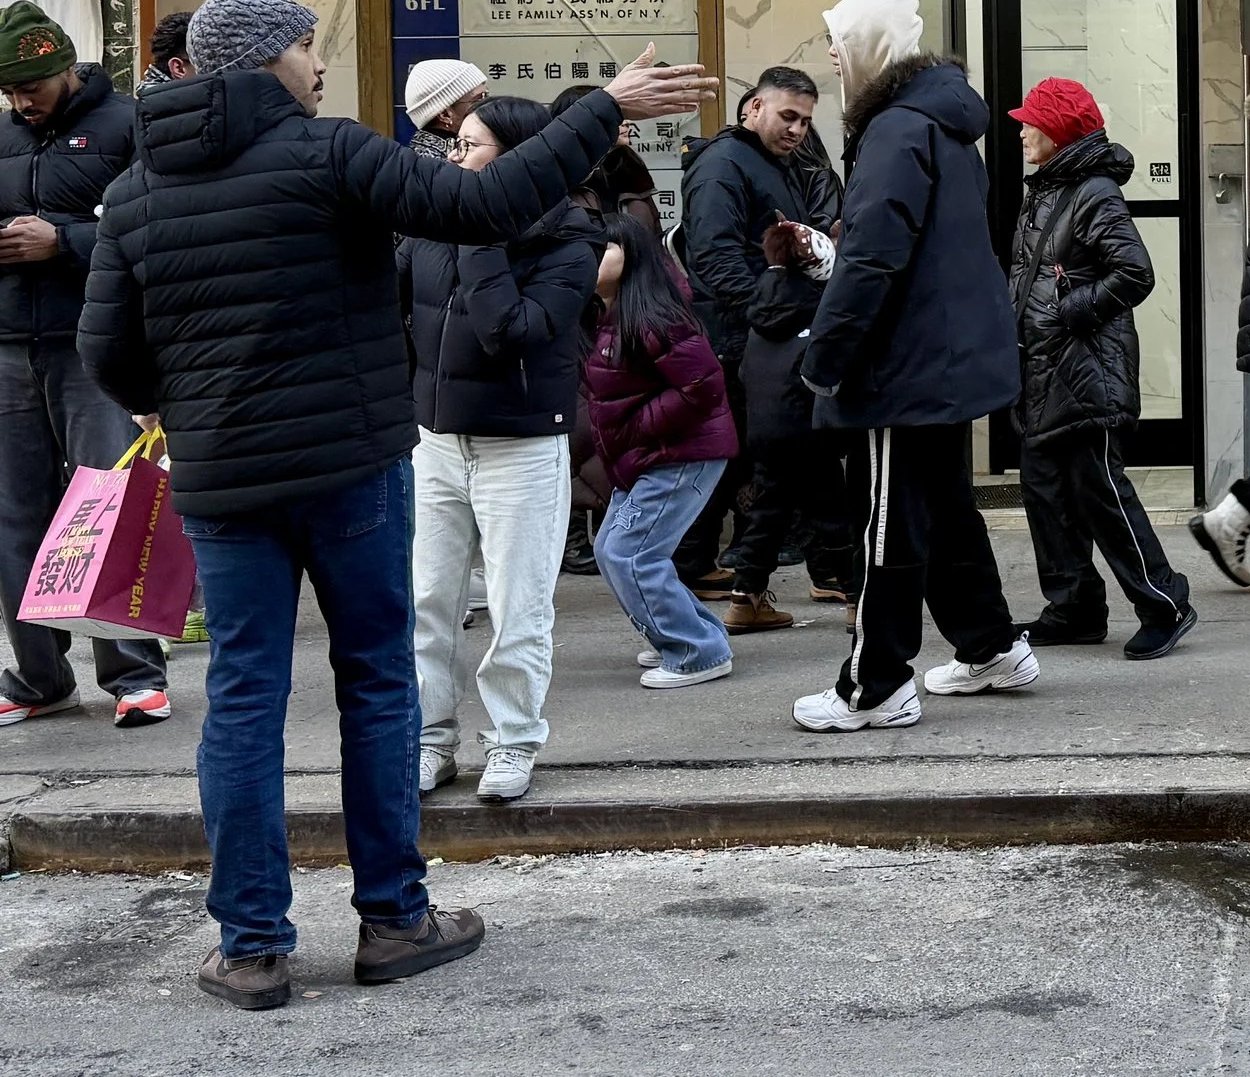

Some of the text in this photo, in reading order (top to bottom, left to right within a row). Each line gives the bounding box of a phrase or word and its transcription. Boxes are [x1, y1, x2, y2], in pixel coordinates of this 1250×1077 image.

[491, 10, 512, 20] LEE
[518, 9, 564, 19] FAMILY
[617, 9, 633, 19] OF
[637, 142, 673, 153] IN NY
[127, 477, 168, 619] HAPPY NEW YEAR
